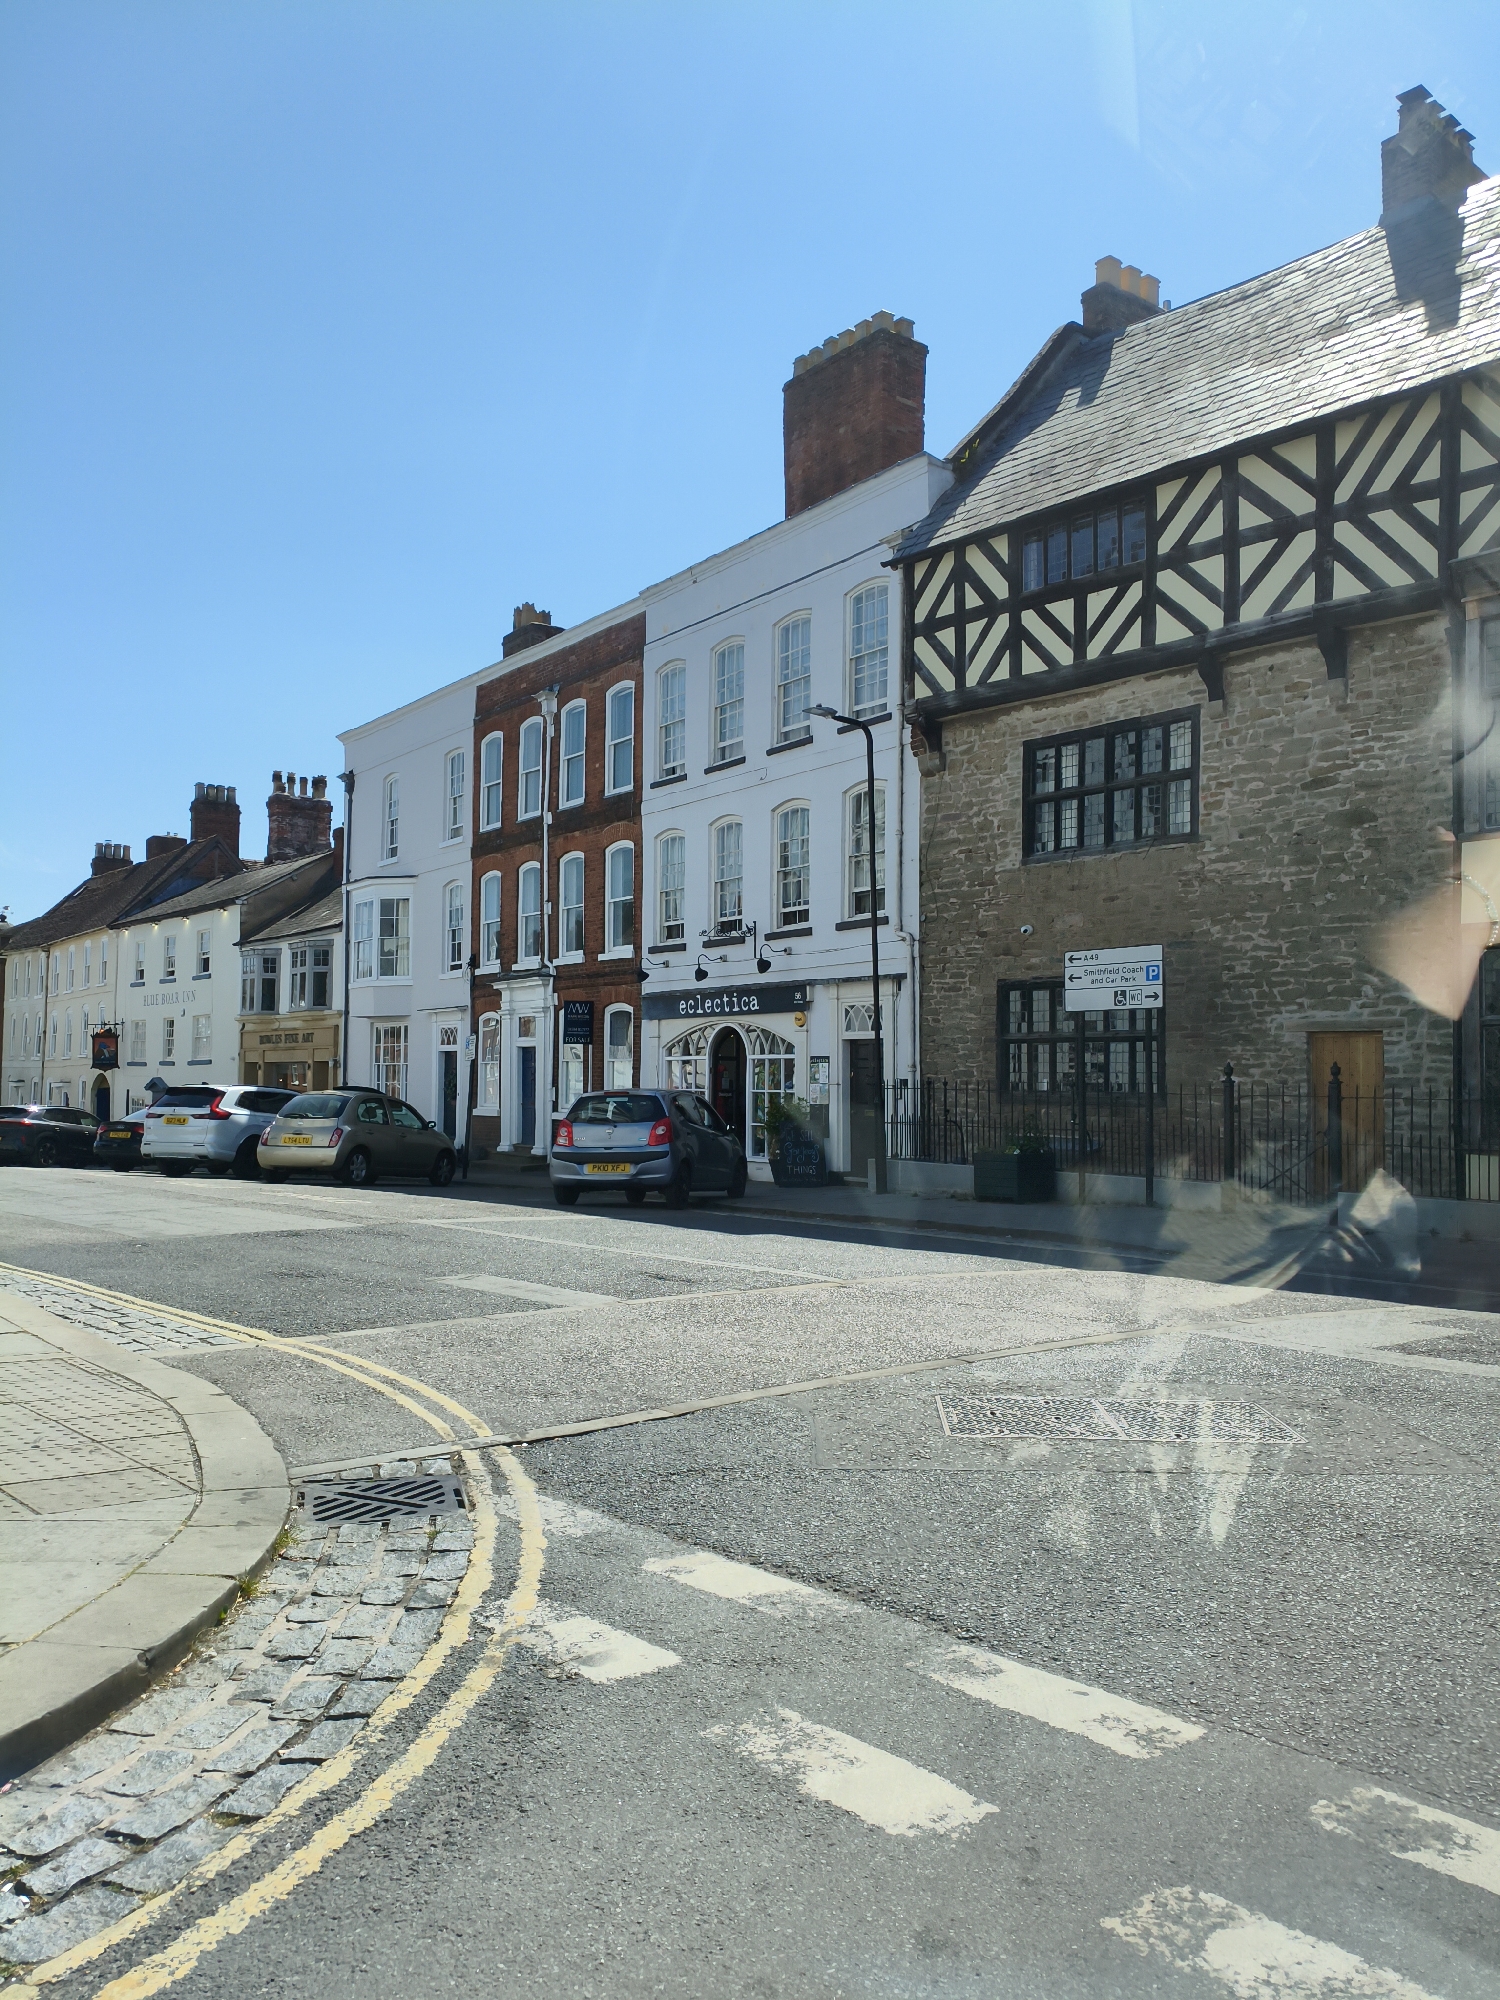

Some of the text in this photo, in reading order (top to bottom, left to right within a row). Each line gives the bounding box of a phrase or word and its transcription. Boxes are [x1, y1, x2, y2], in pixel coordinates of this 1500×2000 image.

[1083, 966, 1144, 976] Smithfield Coach
[1149, 966, 1158, 979] P
[1105, 976, 1118, 984] Car
[1120, 975, 1137, 983] Park
[143, 990, 197, 1006] BLUE BOAR INN
[794, 991, 802, 1000] 56
[1130, 993, 1141, 1002] WC
[679, 992, 760, 1015] eclectica
[301, 1032, 315, 1043] ART
[610, 1164, 626, 1172] XFJ
[786, 1164, 817, 1175] THINGS
